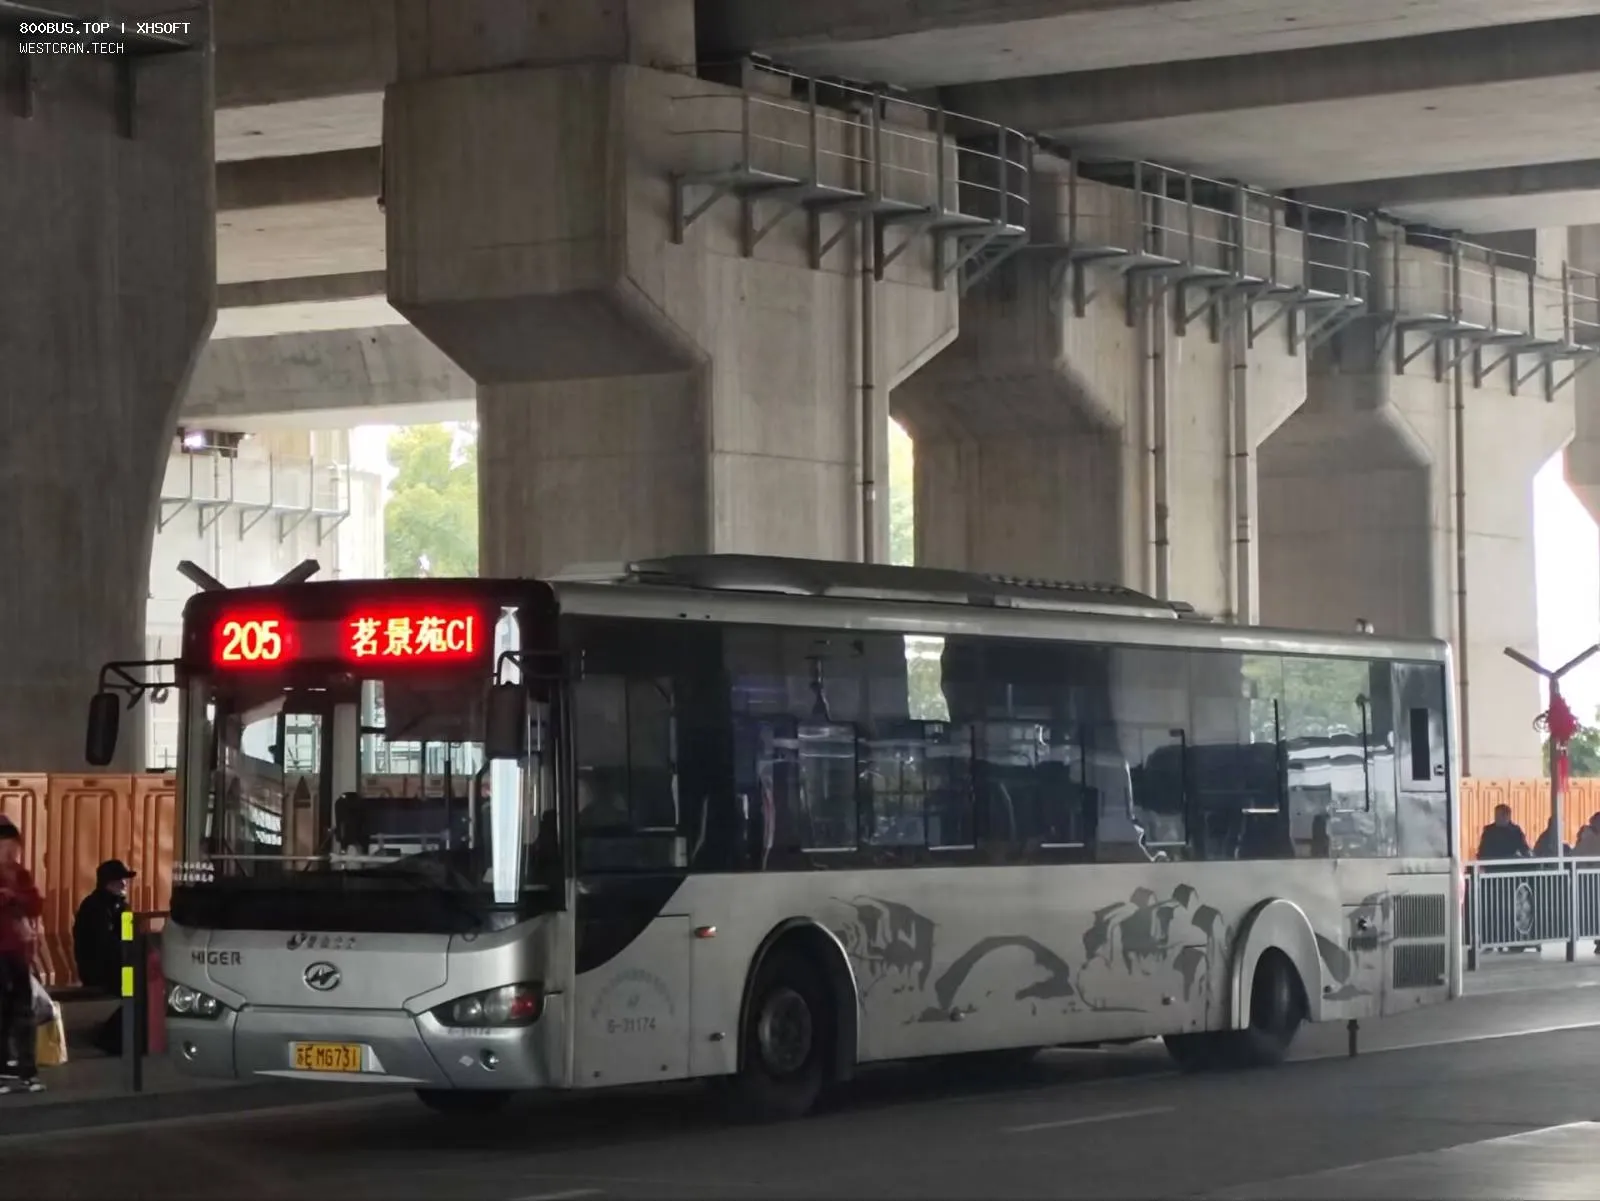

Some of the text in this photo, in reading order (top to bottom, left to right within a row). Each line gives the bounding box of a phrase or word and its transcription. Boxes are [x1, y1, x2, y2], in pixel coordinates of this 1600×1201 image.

[222, 621, 282, 661] 205
[350, 616, 475, 658] 茗景苑C
[192, 951, 242, 965] HIGER
